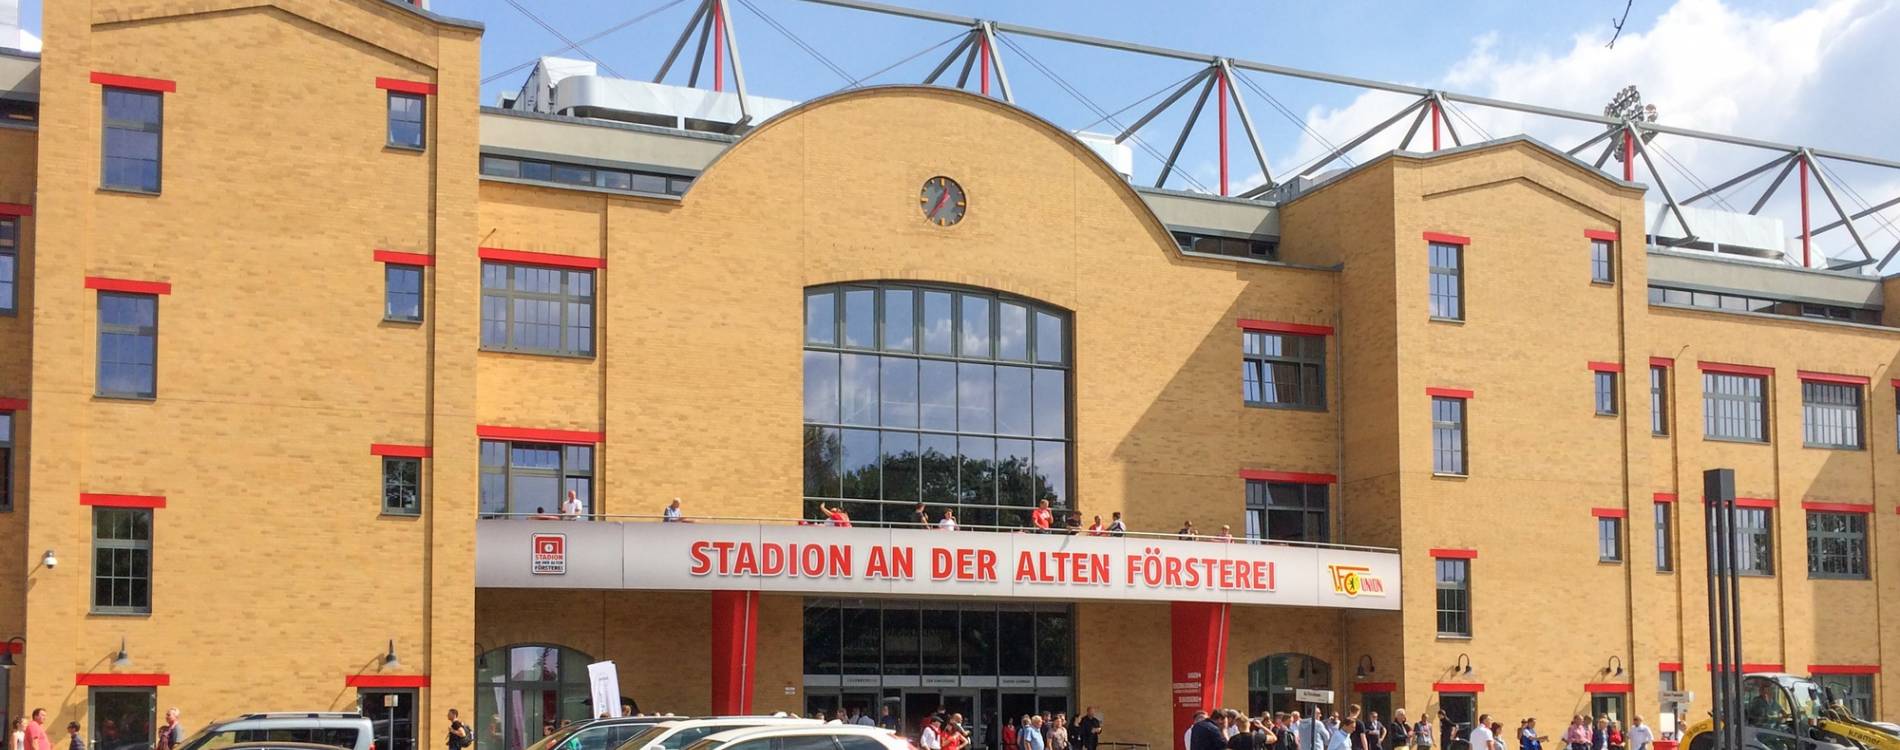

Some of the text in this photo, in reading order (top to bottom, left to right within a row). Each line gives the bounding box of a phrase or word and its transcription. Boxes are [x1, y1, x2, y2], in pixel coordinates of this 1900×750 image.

[690, 540, 1276, 591] STADION AN DER ALTEN FÖRSTEREI
